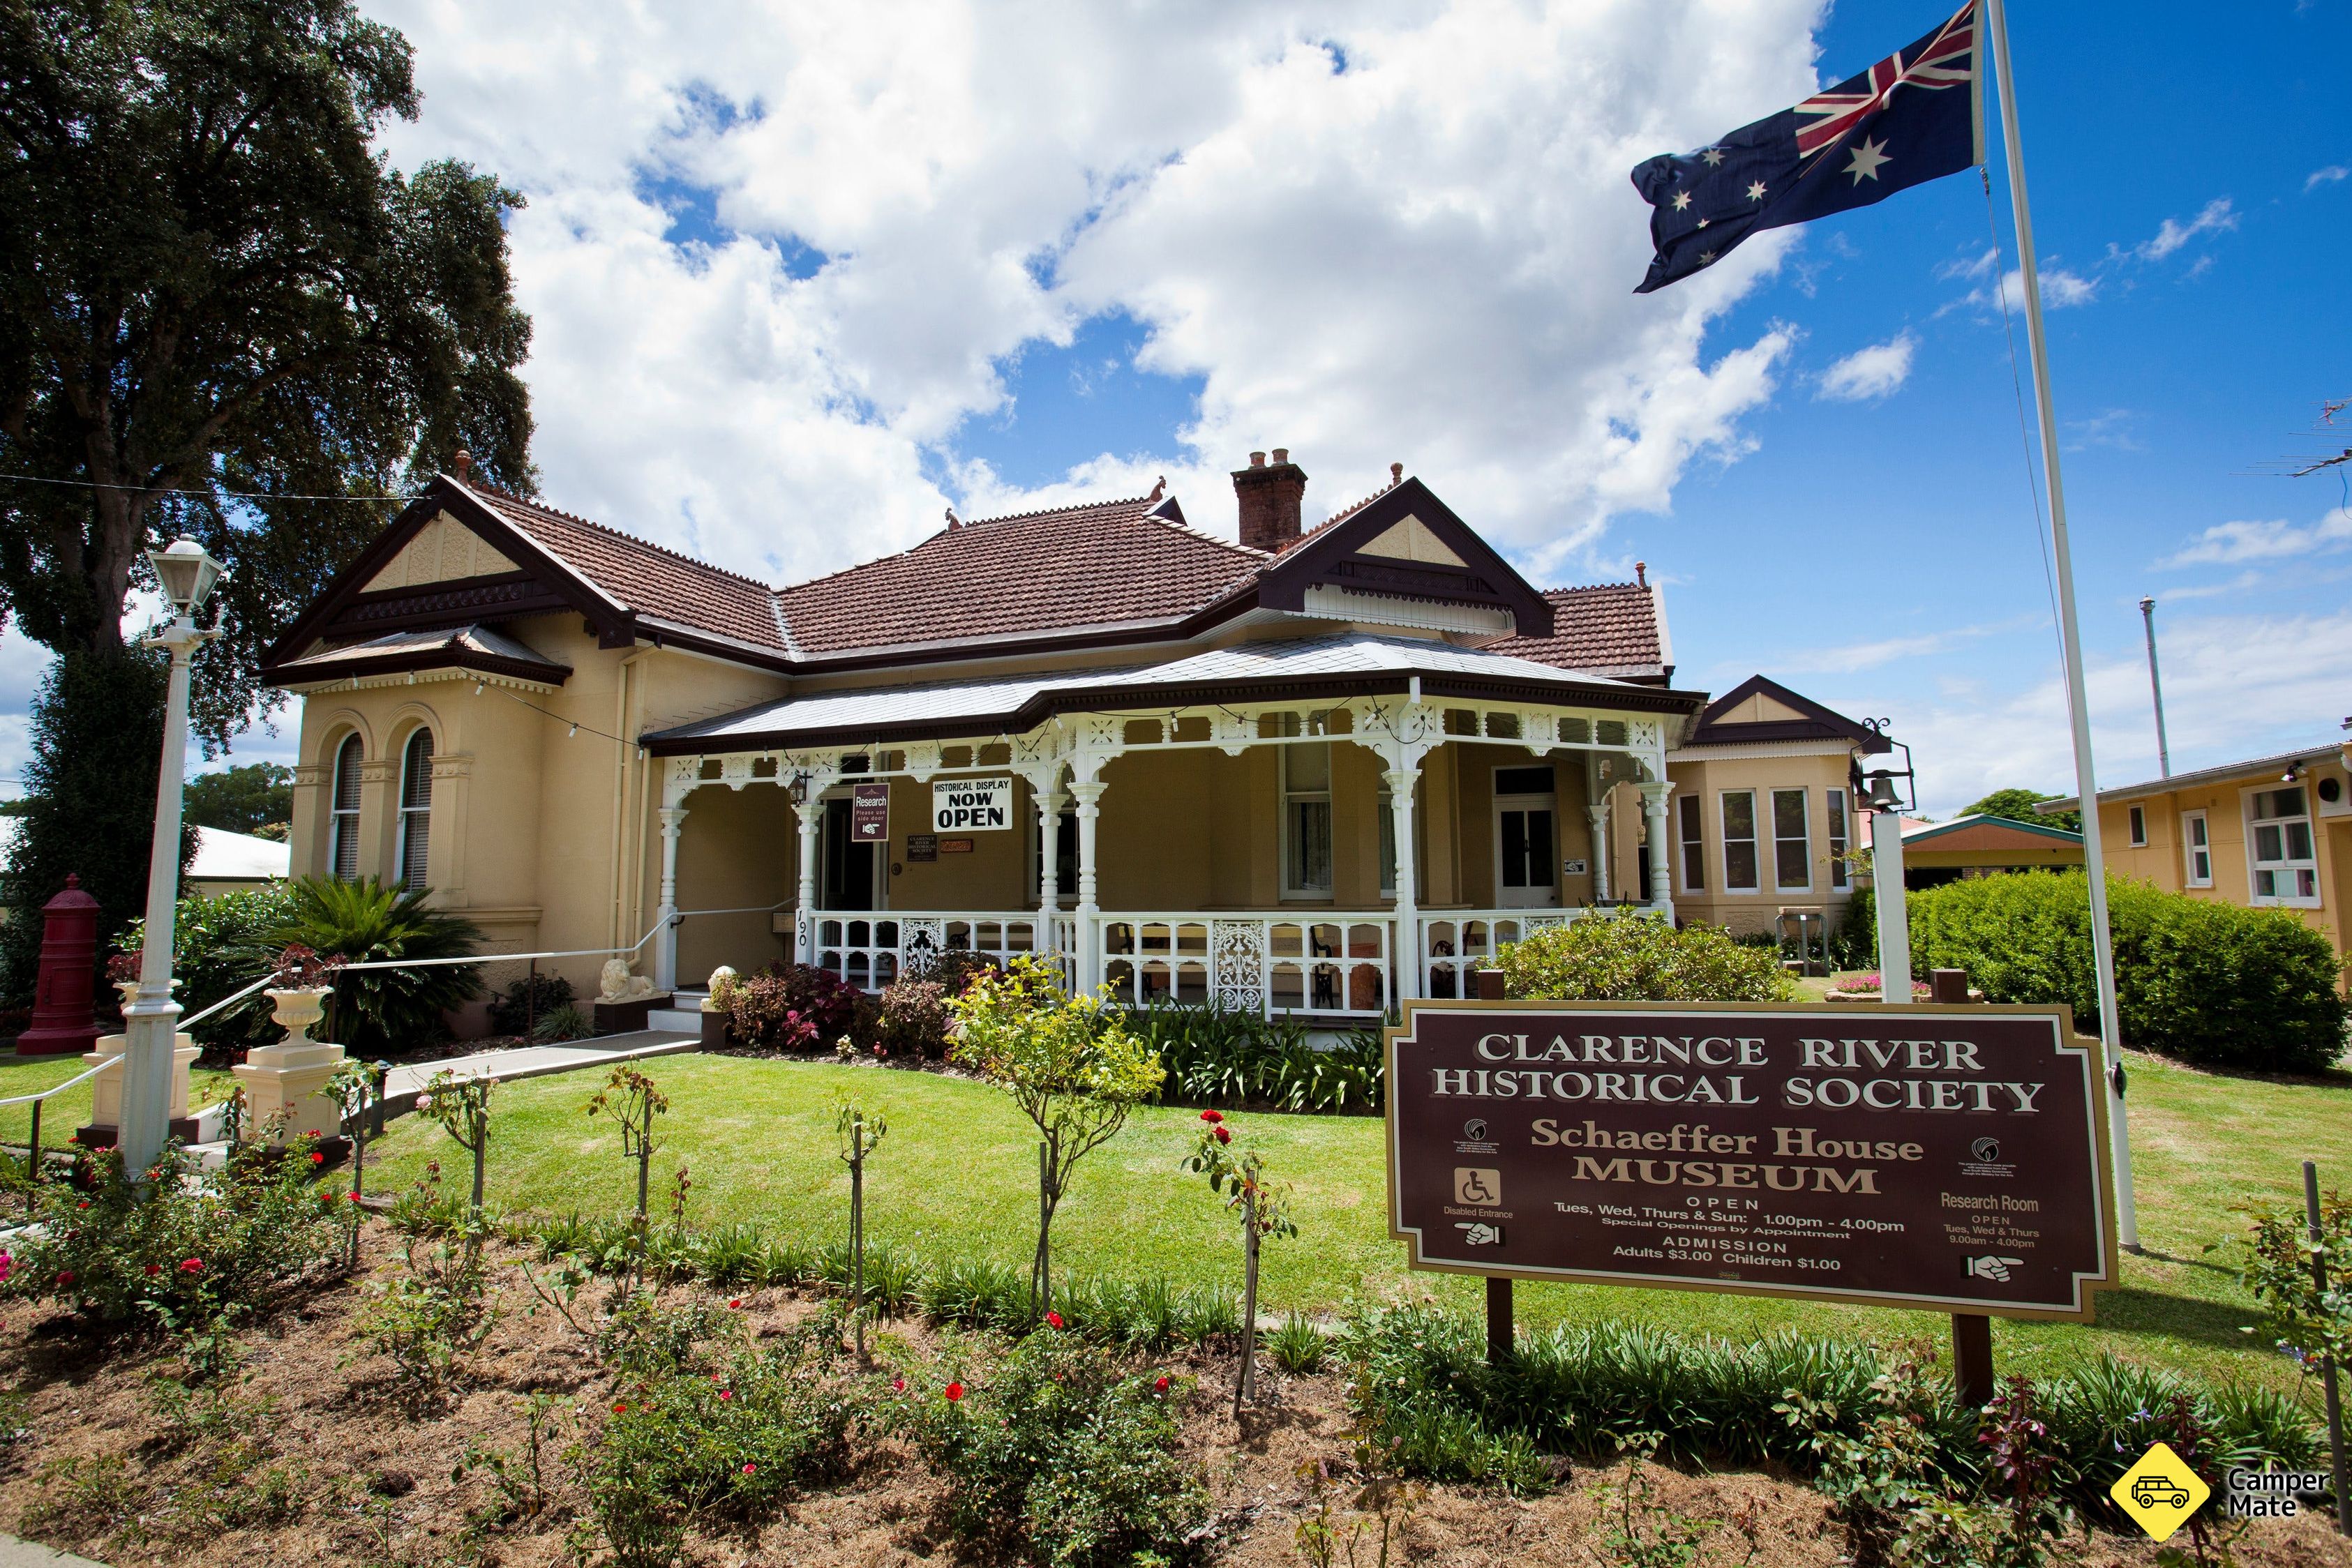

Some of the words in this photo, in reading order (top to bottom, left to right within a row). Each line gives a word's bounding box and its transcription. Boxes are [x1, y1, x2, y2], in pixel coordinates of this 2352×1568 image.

[934, 782, 973, 792] HISTORICAL
[976, 780, 1009, 790] DISPLAY
[855, 795, 887, 807] Research
[949, 792, 993, 807] NOW
[938, 807, 1003, 829] OPEN
[797, 910, 807, 947] 190
[1476, 1033, 1769, 1066] CLARENCE
[1798, 1038, 1986, 1070] RIVER
[1431, 1068, 1760, 1105] HISTORICAL
[1785, 1076, 2045, 1113] SOCIETY
[1531, 1118, 1758, 1155] Schaeffer
[1771, 1126, 1924, 1161] House
[1571, 1155, 1882, 1195] MUSEUM
[1444, 1205, 1477, 1216] Disabled
[1478, 1208, 1513, 1219] Entrance
[1686, 1196, 1758, 1210] OPEN
[1940, 1192, 1998, 1210] Research
[2001, 1195, 2039, 1212] Room
[1554, 1202, 1593, 1215] Tues,
[1598, 1204, 1637, 1218] Wed,
[1641, 1207, 1689, 1219] Thurs
[1693, 1210, 1706, 1221] &
[1711, 1211, 1748, 1223] Sun:
[1763, 1214, 1823, 1228] 1.00pm
[1840, 1218, 1905, 1233] 4.00pm
[1971, 1215, 2010, 1225] OPEN
[1601, 1217, 1652, 1228] Special
[1657, 1221, 1726, 1232] Openings
[1730, 1226, 1748, 1235] by
[1753, 1226, 1850, 1239] Appointment
[1943, 1224, 1970, 1235] Tues,
[1972, 1226, 1995, 1235] Wed
[1998, 1227, 2007, 1236] &
[2009, 1228, 2040, 1237] Thurs
[1662, 1236, 1787, 1253] ADMISSION
[1949, 1235, 1986, 1245] 9.00am
[1996, 1237, 2035, 1249] 4.00pm
[1612, 1246, 1663, 1258] Adults
[1668, 1249, 1713, 1262] $3.00
[1722, 1253, 1792, 1267] Children
[1797, 1258, 1841, 1271] $1.00
